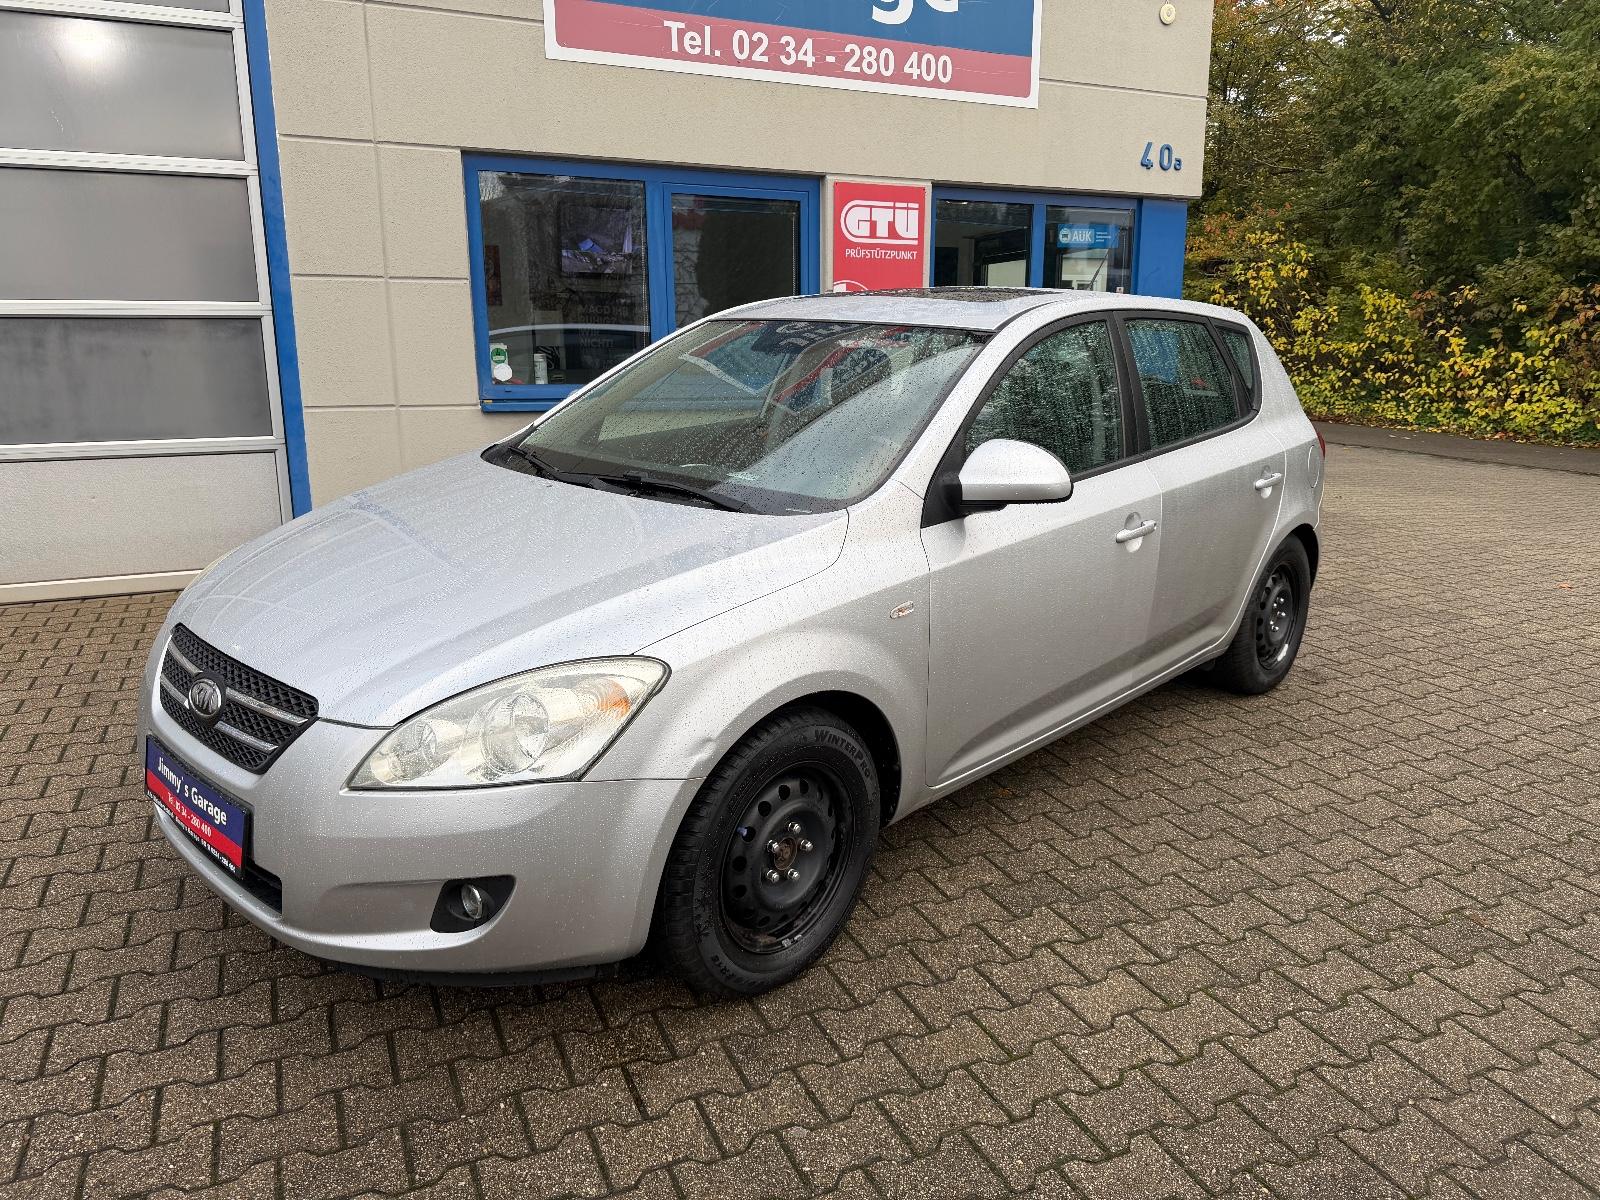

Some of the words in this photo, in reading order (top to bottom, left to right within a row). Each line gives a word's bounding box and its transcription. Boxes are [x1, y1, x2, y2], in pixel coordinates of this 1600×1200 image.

[663, 20, 721, 57] Tel.
[732, 29, 769, 63] 02
[779, 35, 815, 68] 34
[825, 53, 836, 63] -
[844, 43, 895, 77] 280
[903, 51, 952, 83] 400
[1140, 142, 1182, 171] 40a
[844, 201, 919, 240] GTÜ
[845, 247, 918, 260] PRÜFSTÜTZPUNKT
[191, 787, 227, 826] Garage
